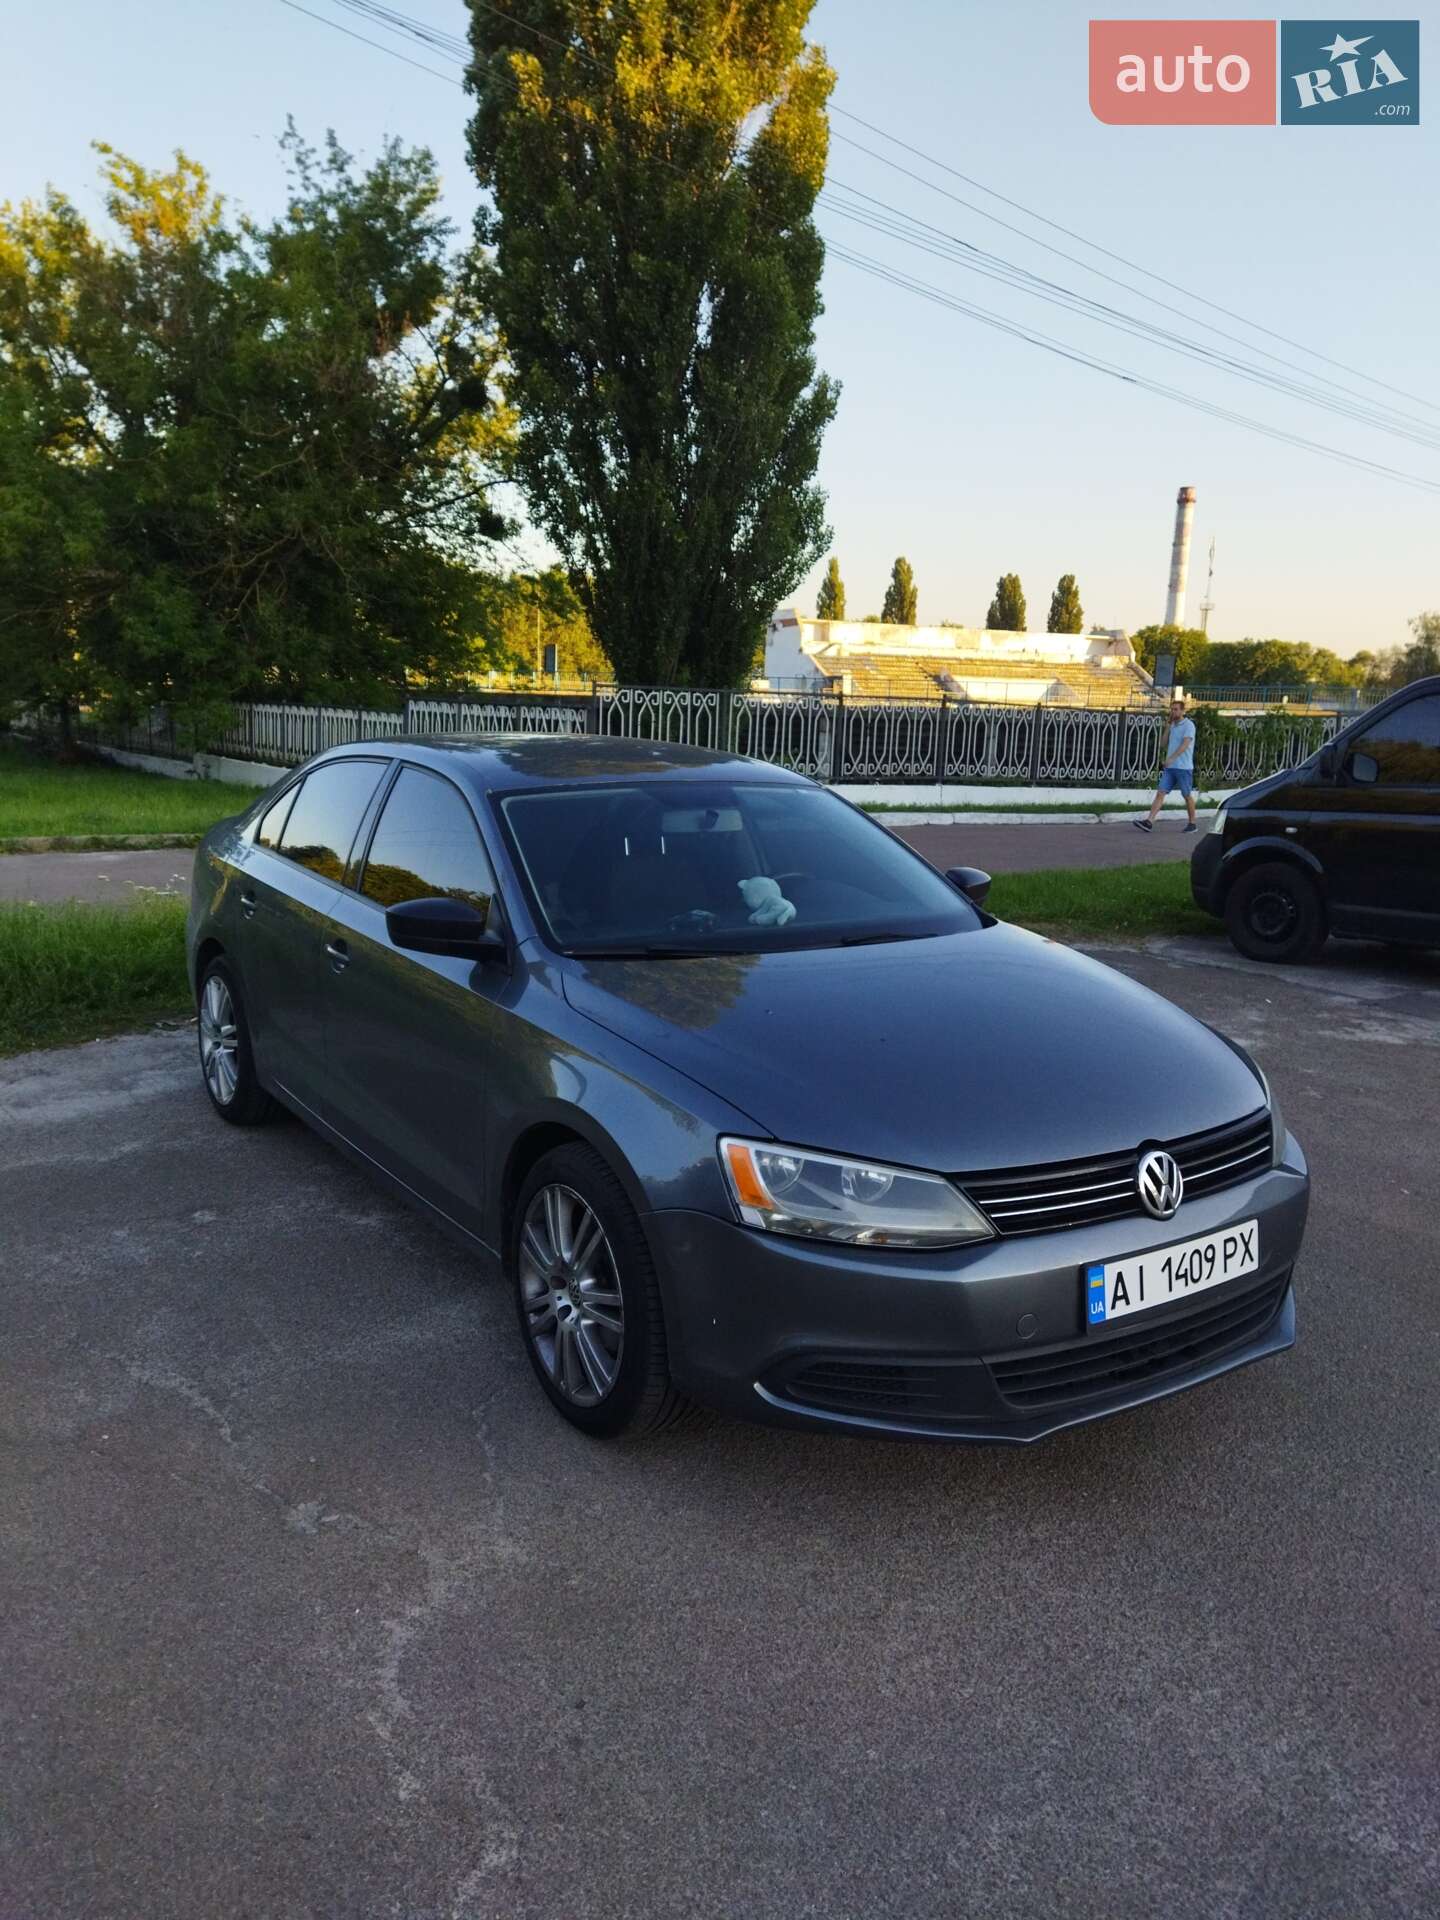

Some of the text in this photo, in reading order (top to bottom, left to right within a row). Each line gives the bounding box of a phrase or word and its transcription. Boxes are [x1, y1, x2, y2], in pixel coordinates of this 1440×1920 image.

[1111, 1228, 1254, 1310] AI 1409 PX
[1091, 1302, 1104, 1314] UA
